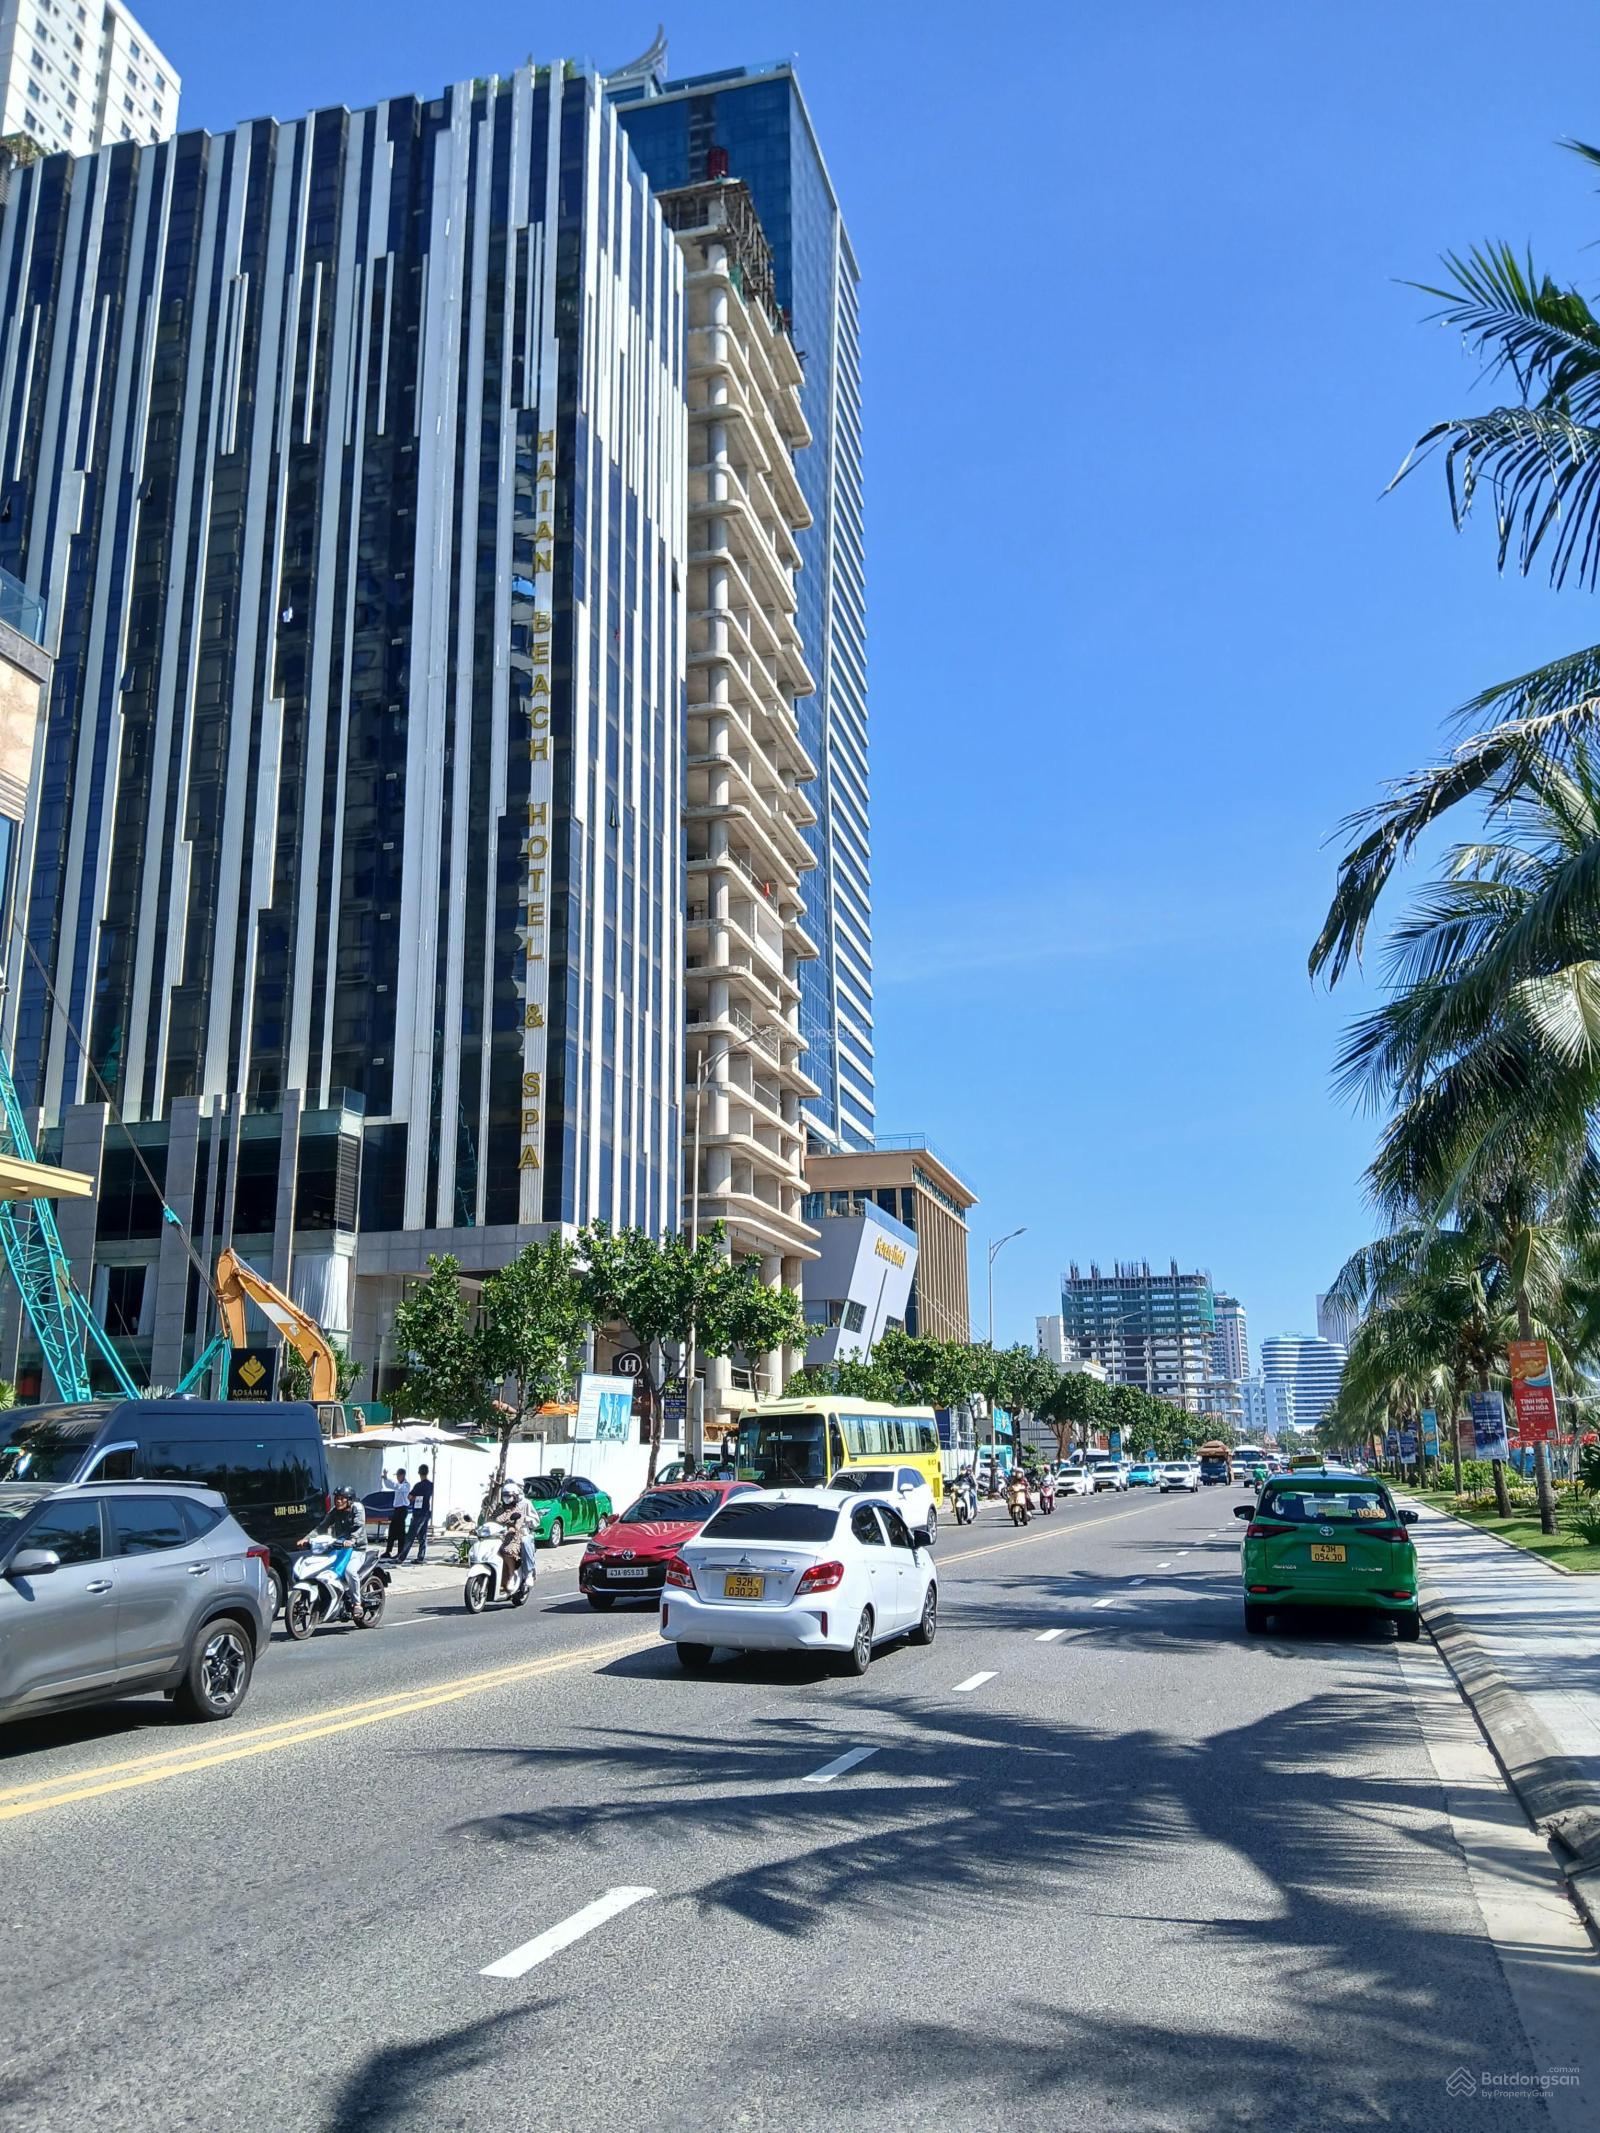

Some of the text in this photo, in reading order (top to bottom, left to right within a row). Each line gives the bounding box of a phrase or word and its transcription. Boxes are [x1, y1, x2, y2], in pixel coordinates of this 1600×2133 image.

[518, 430, 555, 1169] HAIAN BEACH HOTEL & SPA
[1357, 1507, 1387, 1519] 1055
[1320, 1545, 1336, 1553] 43H
[736, 1577, 753, 1587] 92H
[728, 1587, 759, 1597] 030.23
